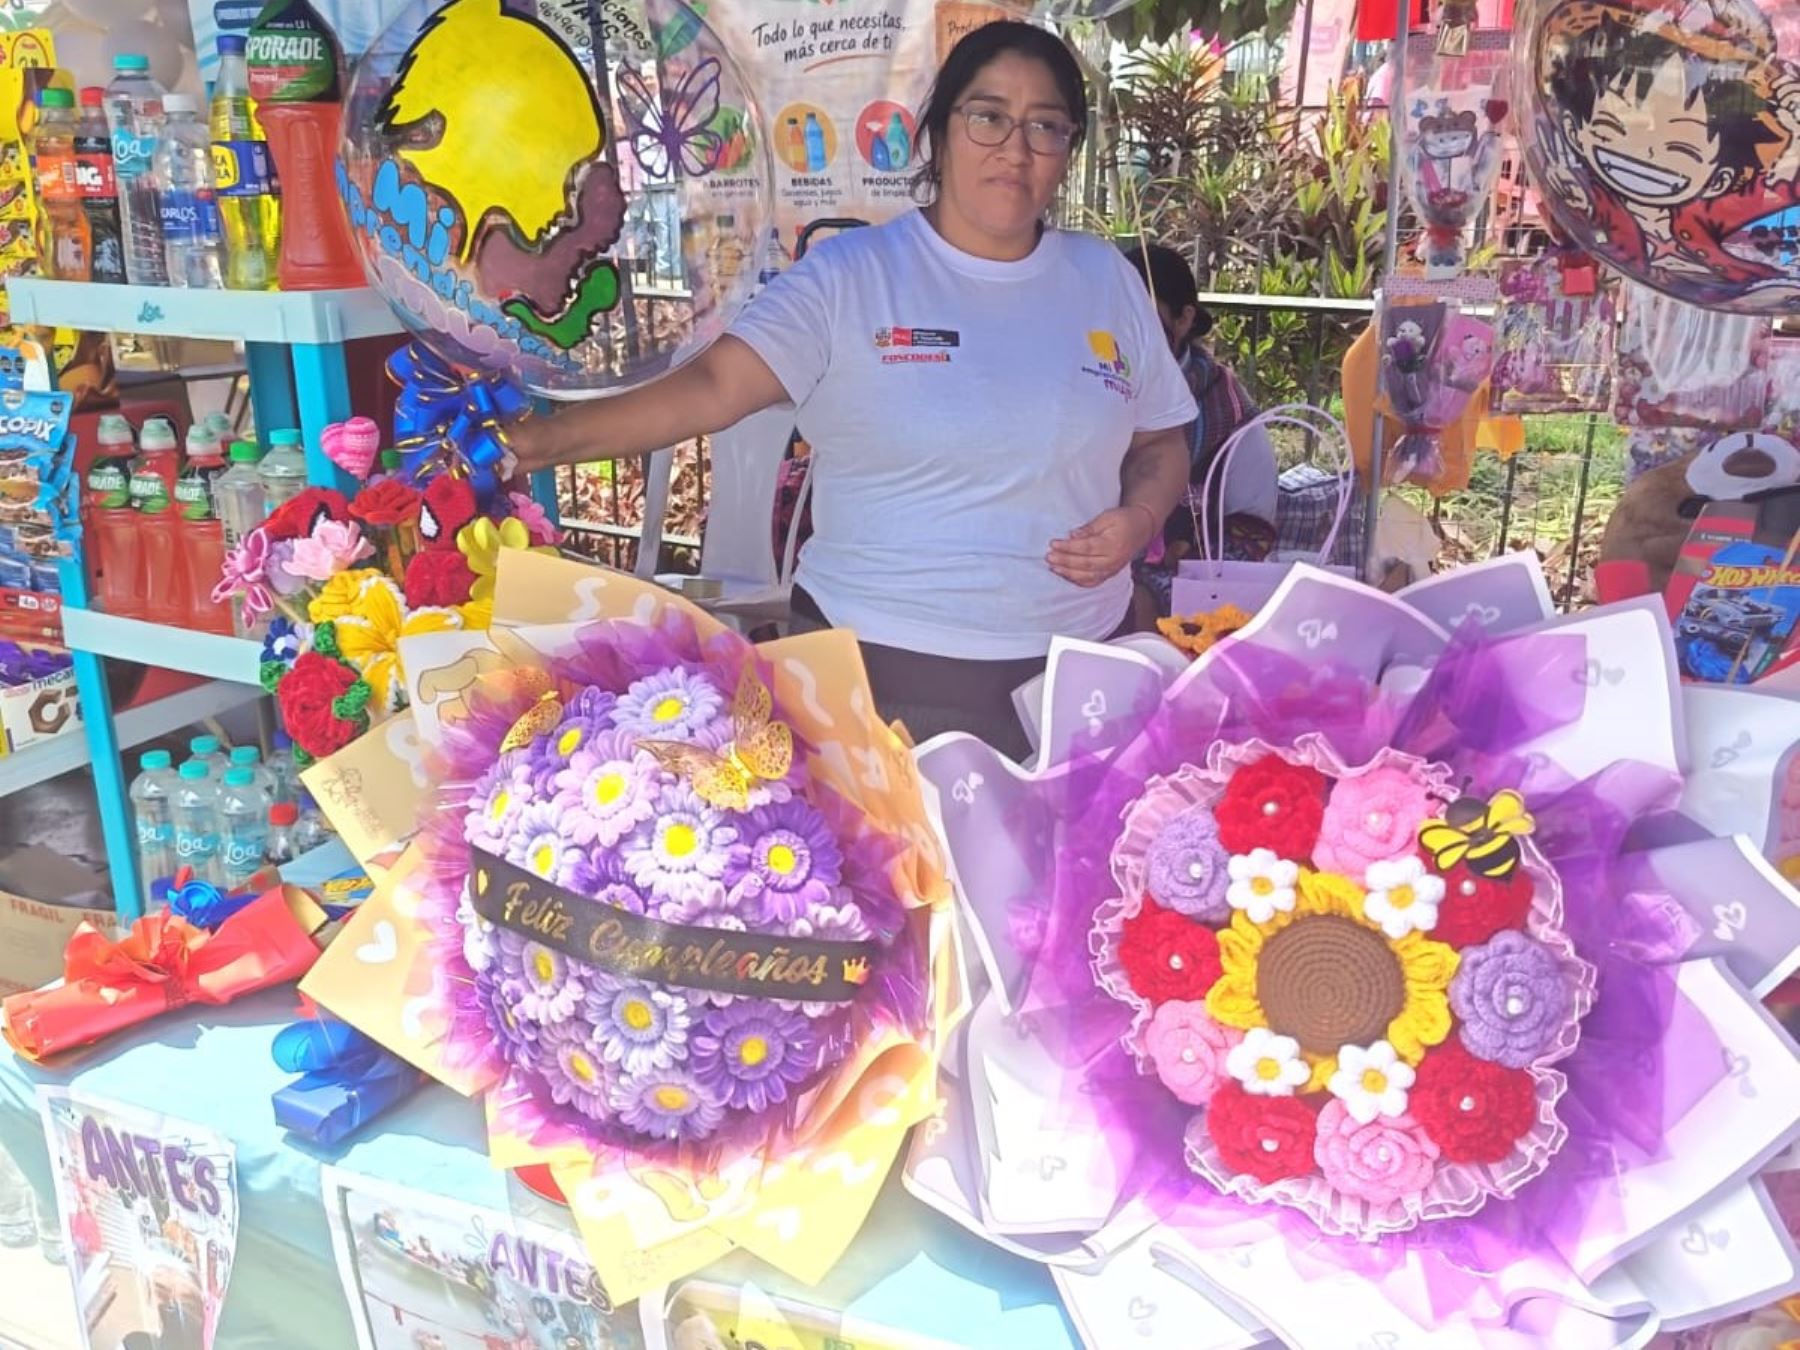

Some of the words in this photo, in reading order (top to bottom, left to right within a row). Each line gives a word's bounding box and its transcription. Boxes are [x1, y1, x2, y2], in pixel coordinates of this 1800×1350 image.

[751, 22, 787, 48] Todo
[792, 20, 804, 39] lo
[810, 19, 834, 37] que
[838, 13, 907, 32] necesitas,
[784, 41, 815, 63] más
[820, 38, 857, 52] cerca
[862, 31, 878, 49] de
[882, 31, 893, 49] ti
[373, 159, 456, 266] Mi
[862, 177, 918, 187] PRODUCTO
[505, 880, 577, 941] Feliz
[588, 918, 830, 986] Cumpleaños
[81, 1115, 221, 1217] ANTES
[487, 1232, 613, 1314] ANTES
